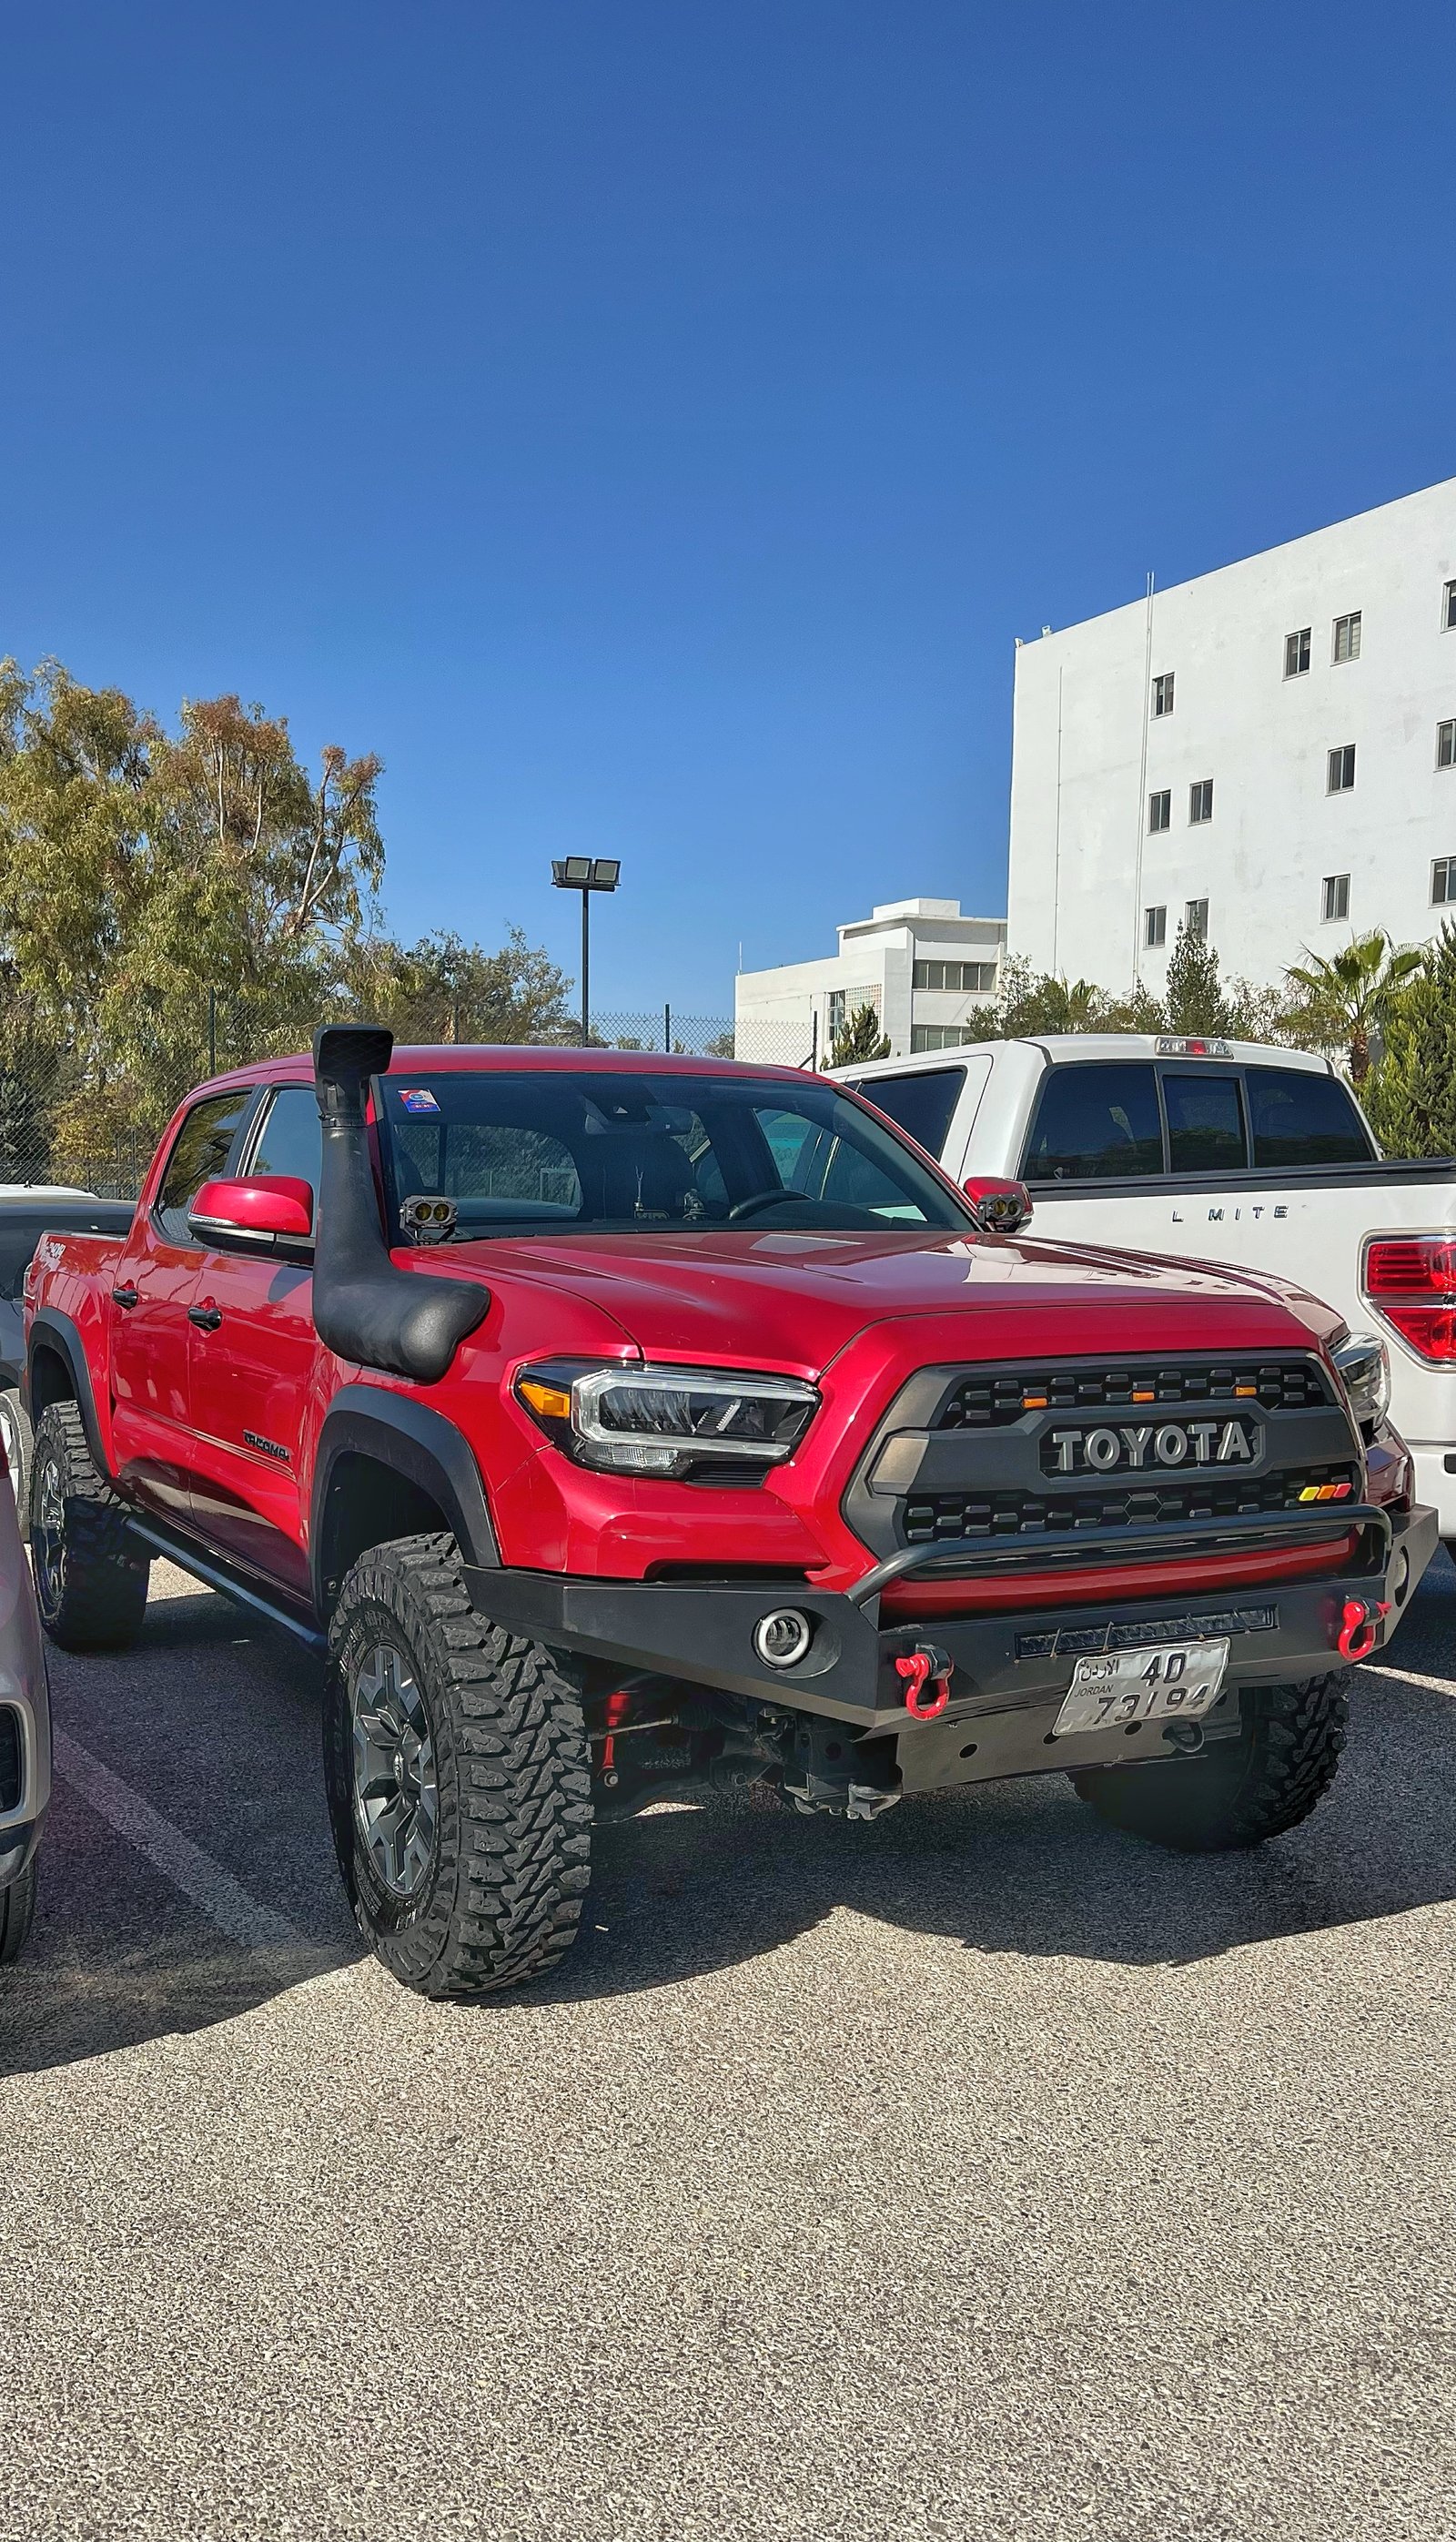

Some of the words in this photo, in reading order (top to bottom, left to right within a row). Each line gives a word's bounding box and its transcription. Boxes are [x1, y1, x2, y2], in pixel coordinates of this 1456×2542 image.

[1052, 1421, 1251, 1472] TOYOTA
[1140, 1652, 1187, 1687] 40
[1074, 1684, 1114, 1698] JORDAN
[1093, 1684, 1211, 1726] 73194
